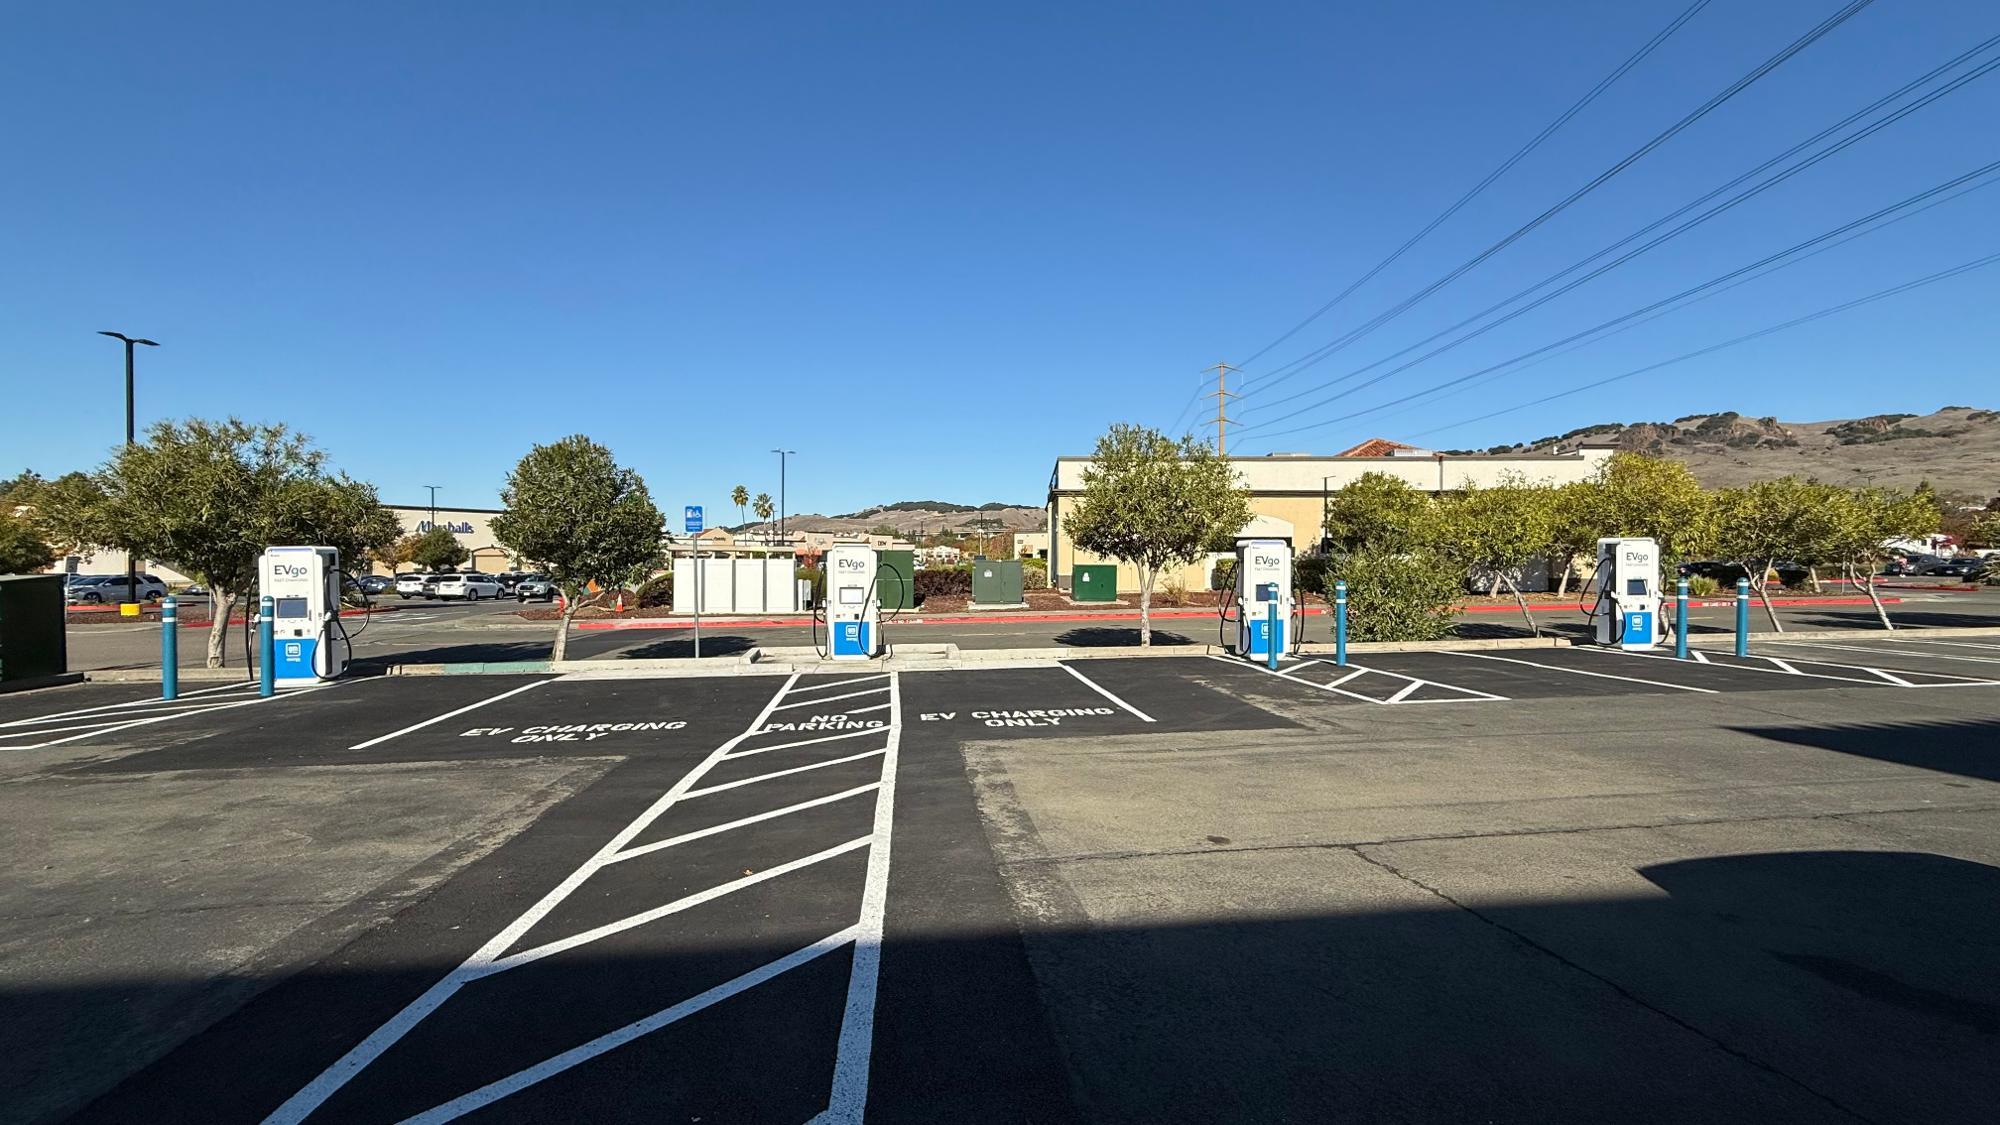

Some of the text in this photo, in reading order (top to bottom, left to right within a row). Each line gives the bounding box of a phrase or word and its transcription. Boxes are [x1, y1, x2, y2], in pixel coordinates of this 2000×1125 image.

[1255, 556, 1280, 567] EVgo
[1626, 552, 1649, 563] EVgo
[839, 559, 865, 570] EVgo
[274, 565, 308, 577] EVgo
[810, 714, 848, 723] NO
[920, 707, 1115, 721] EV CHARGING
[763, 720, 884, 732] PARKING
[984, 717, 1061, 727] ONLY
[459, 721, 688, 736] EV CHARGING
[511, 732, 609, 743] ONLY
